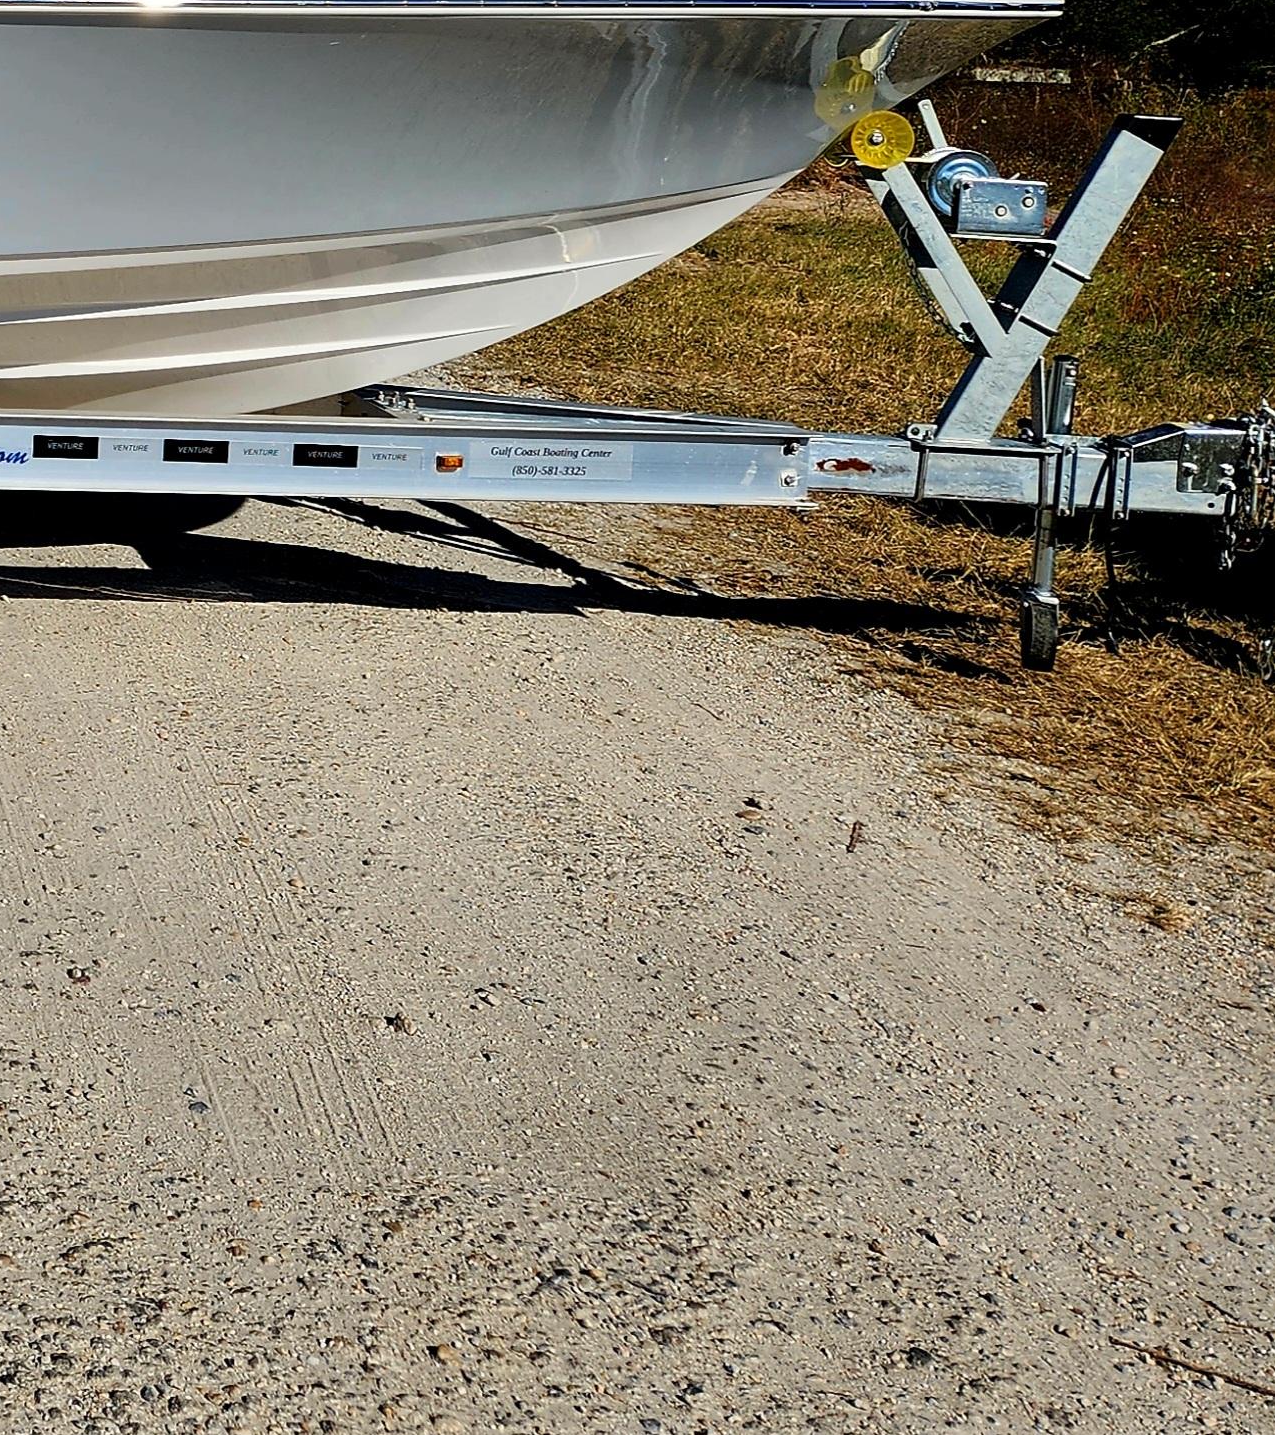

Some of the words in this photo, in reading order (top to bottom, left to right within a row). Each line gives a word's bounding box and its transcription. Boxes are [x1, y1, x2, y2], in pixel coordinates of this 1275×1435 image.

[47, 442, 85, 451] VENTURE
[112, 444, 150, 452] VENTURE
[177, 446, 215, 454] VENTURE
[243, 448, 280, 457] VENTURE
[307, 450, 344, 459] VENTURE
[371, 453, 408, 462] VENTURE
[490, 446, 513, 458] Gulf
[514, 447, 541, 457] Coast
[543, 447, 579, 459] Boating
[581, 448, 613, 458] Center
[511, 465, 587, 478] (850)-581-3325
